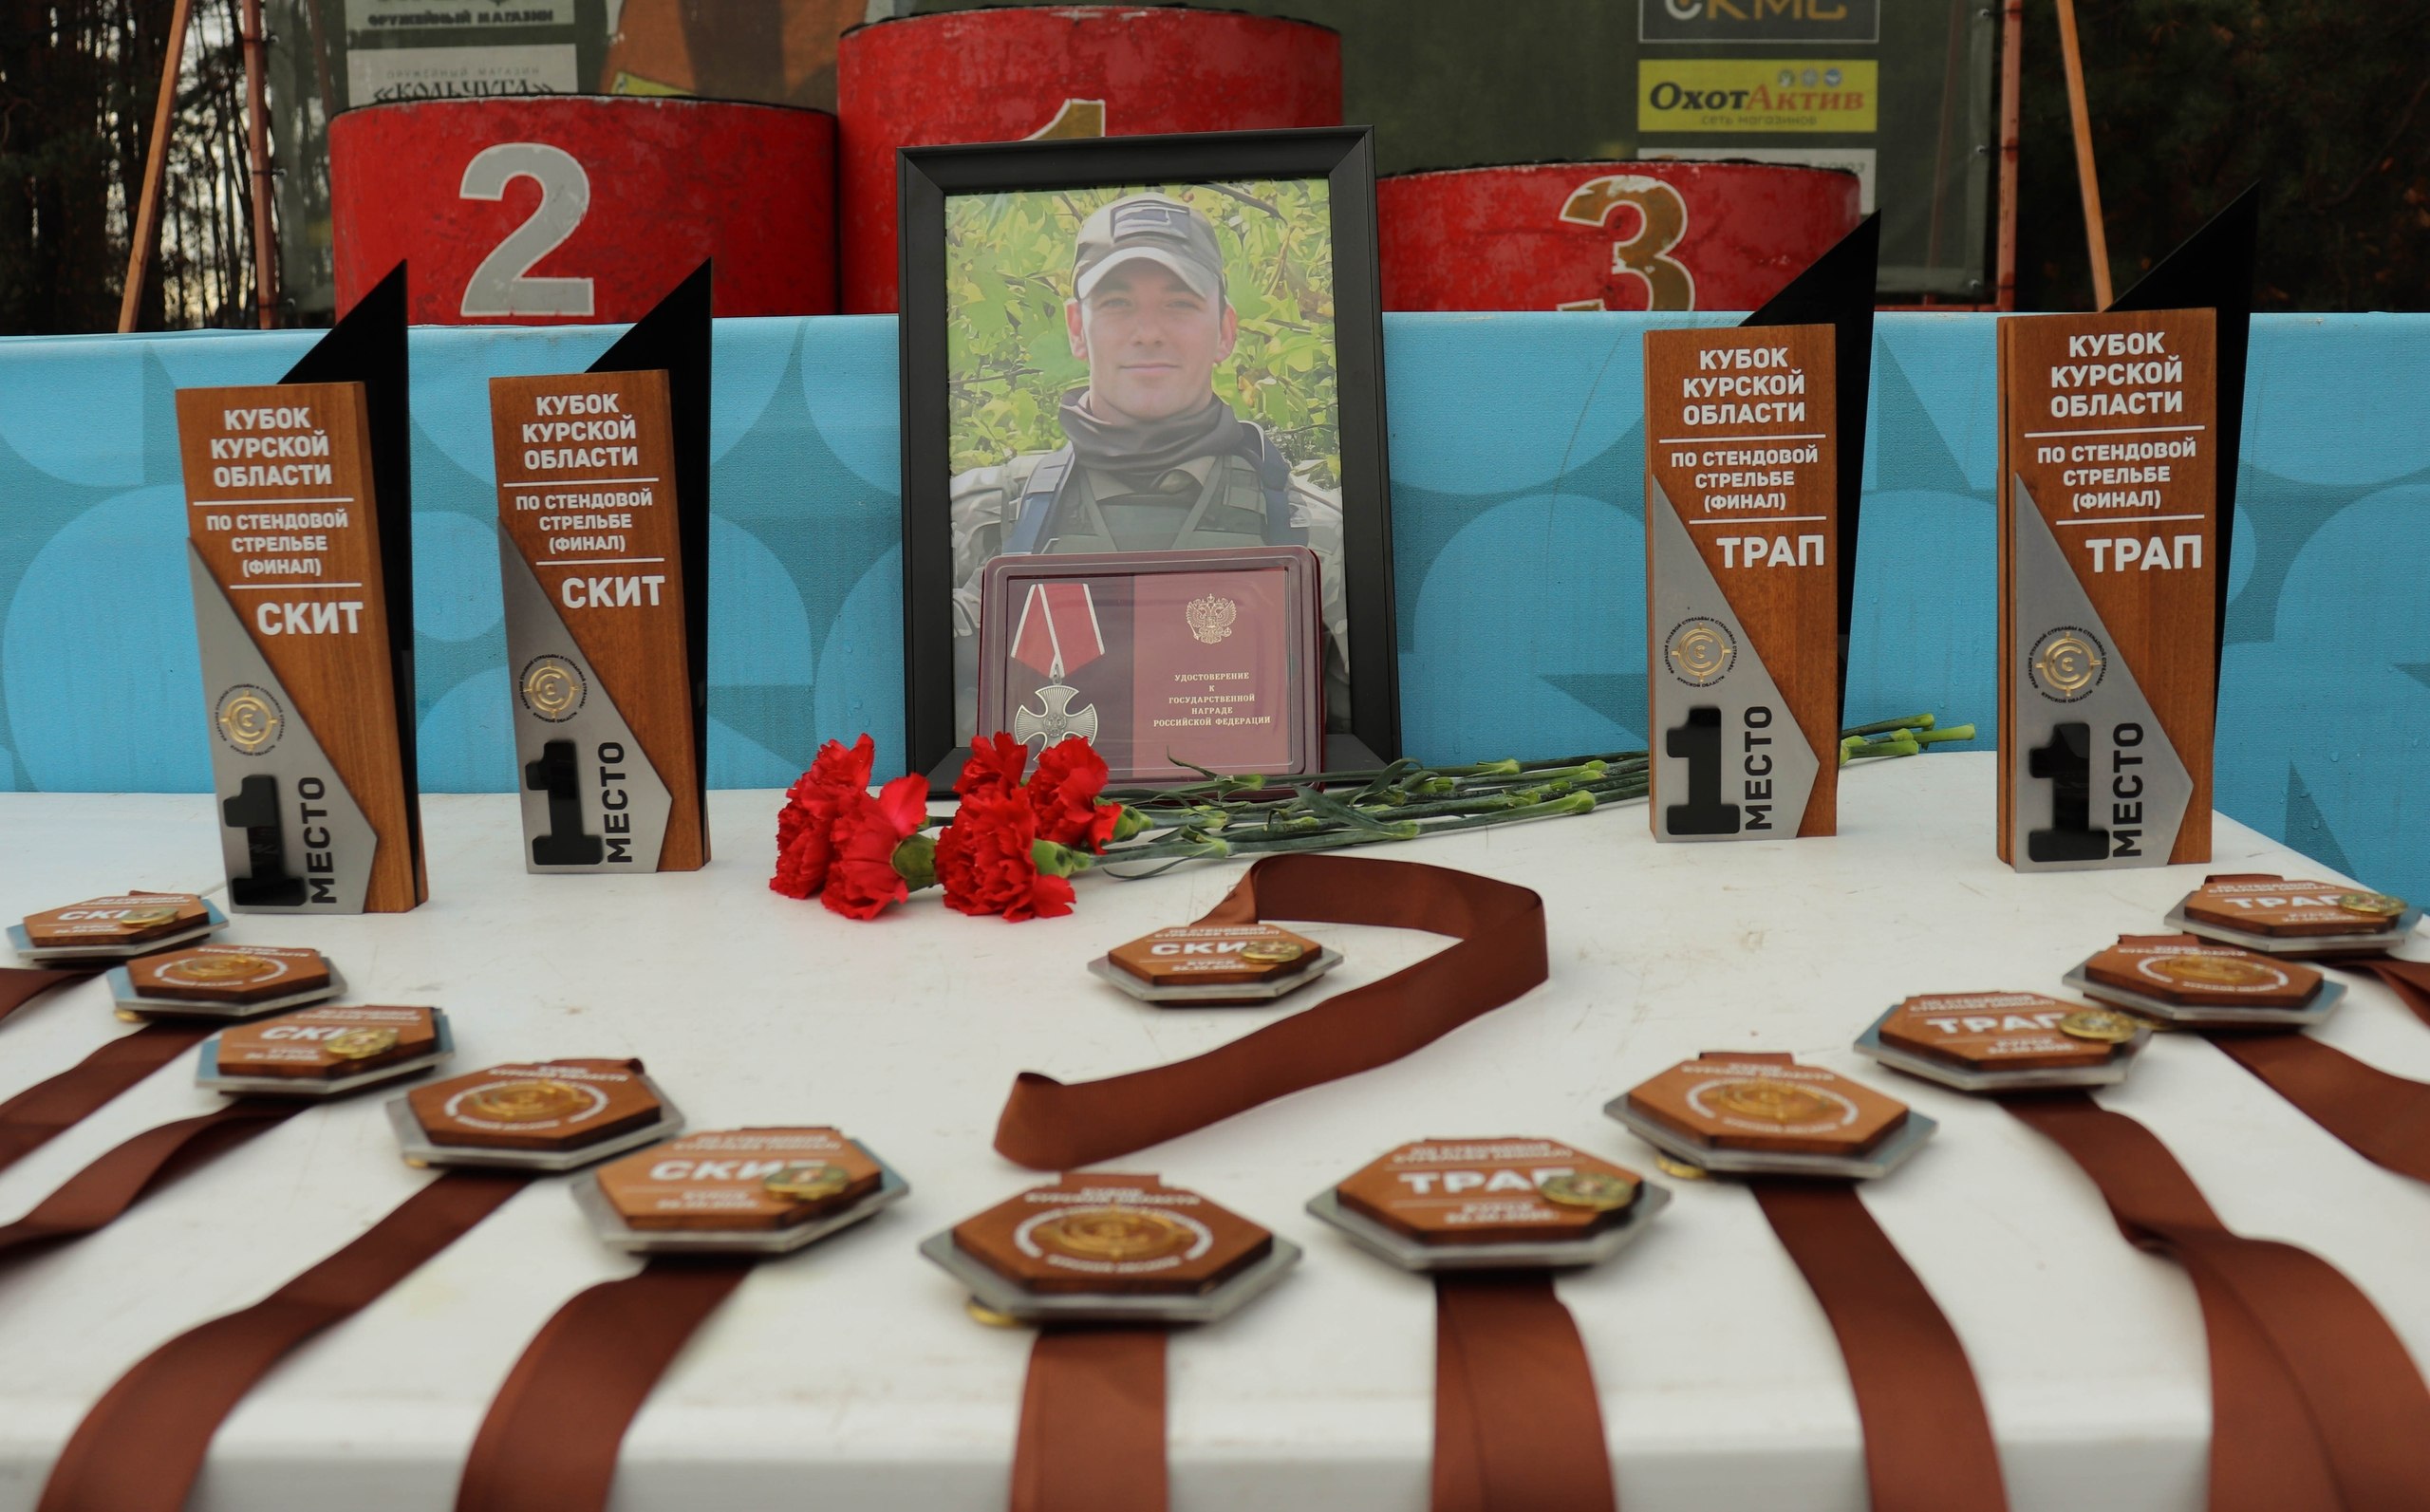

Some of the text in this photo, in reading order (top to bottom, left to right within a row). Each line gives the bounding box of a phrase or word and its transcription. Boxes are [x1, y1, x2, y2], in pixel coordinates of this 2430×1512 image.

[459, 142, 595, 318] 2
[1557, 175, 1696, 311] 3
[2069, 332, 2165, 358] КУБОК
[1700, 347, 1788, 370] КУБОК
[1683, 368, 1805, 398] КУРСКОЙ
[2051, 354, 2182, 388] КУРСКОЙ
[536, 393, 619, 416] КУБОК
[1683, 401, 1805, 425] ОБЛАСТИ
[2050, 391, 2182, 418] ОБЛАСТИ
[224, 407, 310, 430] КУБОК
[522, 414, 636, 443] КУРСКОЙ
[211, 429, 329, 459] КУРСКОЙ
[1672, 444, 1818, 467] ПО СТЕНДОВОЙ
[2038, 437, 2196, 463] ПО СТЕНДОВОЙ
[524, 446, 638, 470] ОБЛАСТИ
[214, 464, 332, 488] ОБЛАСТИ
[1695, 471, 1794, 489] СТРЕЛЬБЕ
[2064, 466, 2170, 486] СТРЕЛЬБЕ
[515, 488, 653, 511] ПО СТЕНДОВОЙ
[1704, 493, 1786, 513] (ФИНАЛ)
[2072, 490, 2161, 513] (ФИНАЛ)
[206, 508, 348, 531] ПО СТЕНДОВОЙ
[539, 513, 632, 532] СТРЕЛЬБЕ
[232, 535, 327, 552] СТРЕЛЬБЕ
[549, 535, 626, 554] (ФИНАЛ)
[1716, 534, 1824, 569] ТРАП
[2085, 534, 2202, 572] ТРАП
[242, 558, 322, 578] (ФИНАЛ)
[562, 575, 665, 609] СКИТ
[256, 601, 364, 636] СКИТ
[1174, 672, 1249, 682] УДОСТОВЕРЕНИЕ
[1168, 694, 1255, 704] ГОСУДАРСТВЕННОЙ
[1191, 706, 1233, 715] НАГРАДЕ
[1153, 716, 1271, 727] РОССИЙСКОЙ ФЕДЕРАЦИИ
[1666, 706, 1740, 835] 1
[1744, 706, 1772, 831] МЕСТО
[525, 737, 604, 866] 1
[2028, 722, 2109, 863] 1
[2113, 722, 2144, 857] МЕСТО
[598, 741, 633, 864] МЕСТО
[223, 774, 308, 906] 1
[298, 776, 337, 904] МЕСТО
[58, 909, 133, 921] СК
[1150, 942, 1253, 956] СКИ
[260, 1025, 348, 1041] СК
